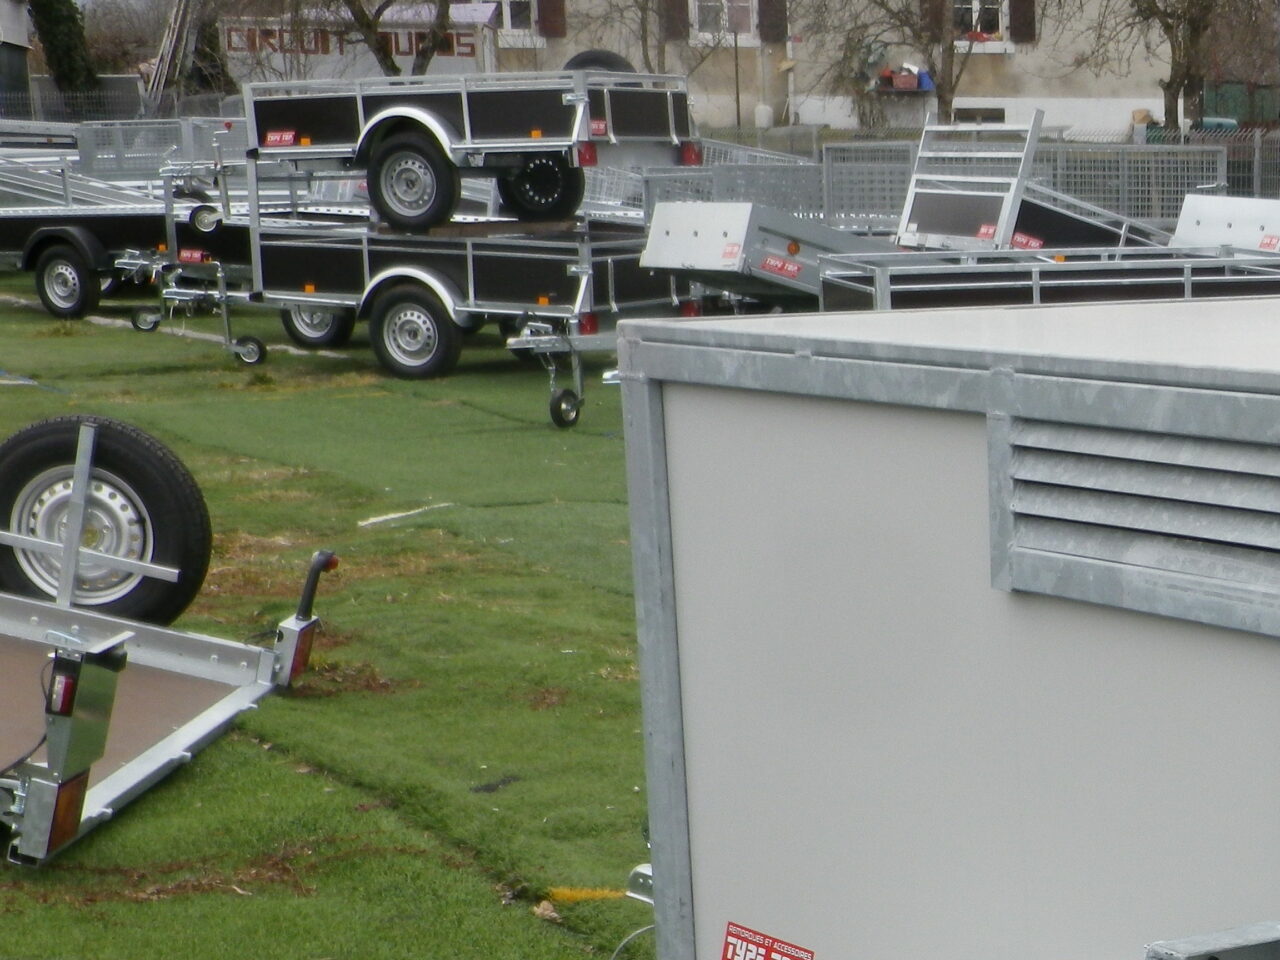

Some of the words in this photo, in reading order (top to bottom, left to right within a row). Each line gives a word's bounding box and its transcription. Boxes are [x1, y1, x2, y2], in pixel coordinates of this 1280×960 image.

[226, 27, 349, 56] CIRCUIT
[729, 924, 764, 944] REMORQUES
[765, 937, 773, 947] ET
[773, 941, 812, 960] ACCESSOIRES
